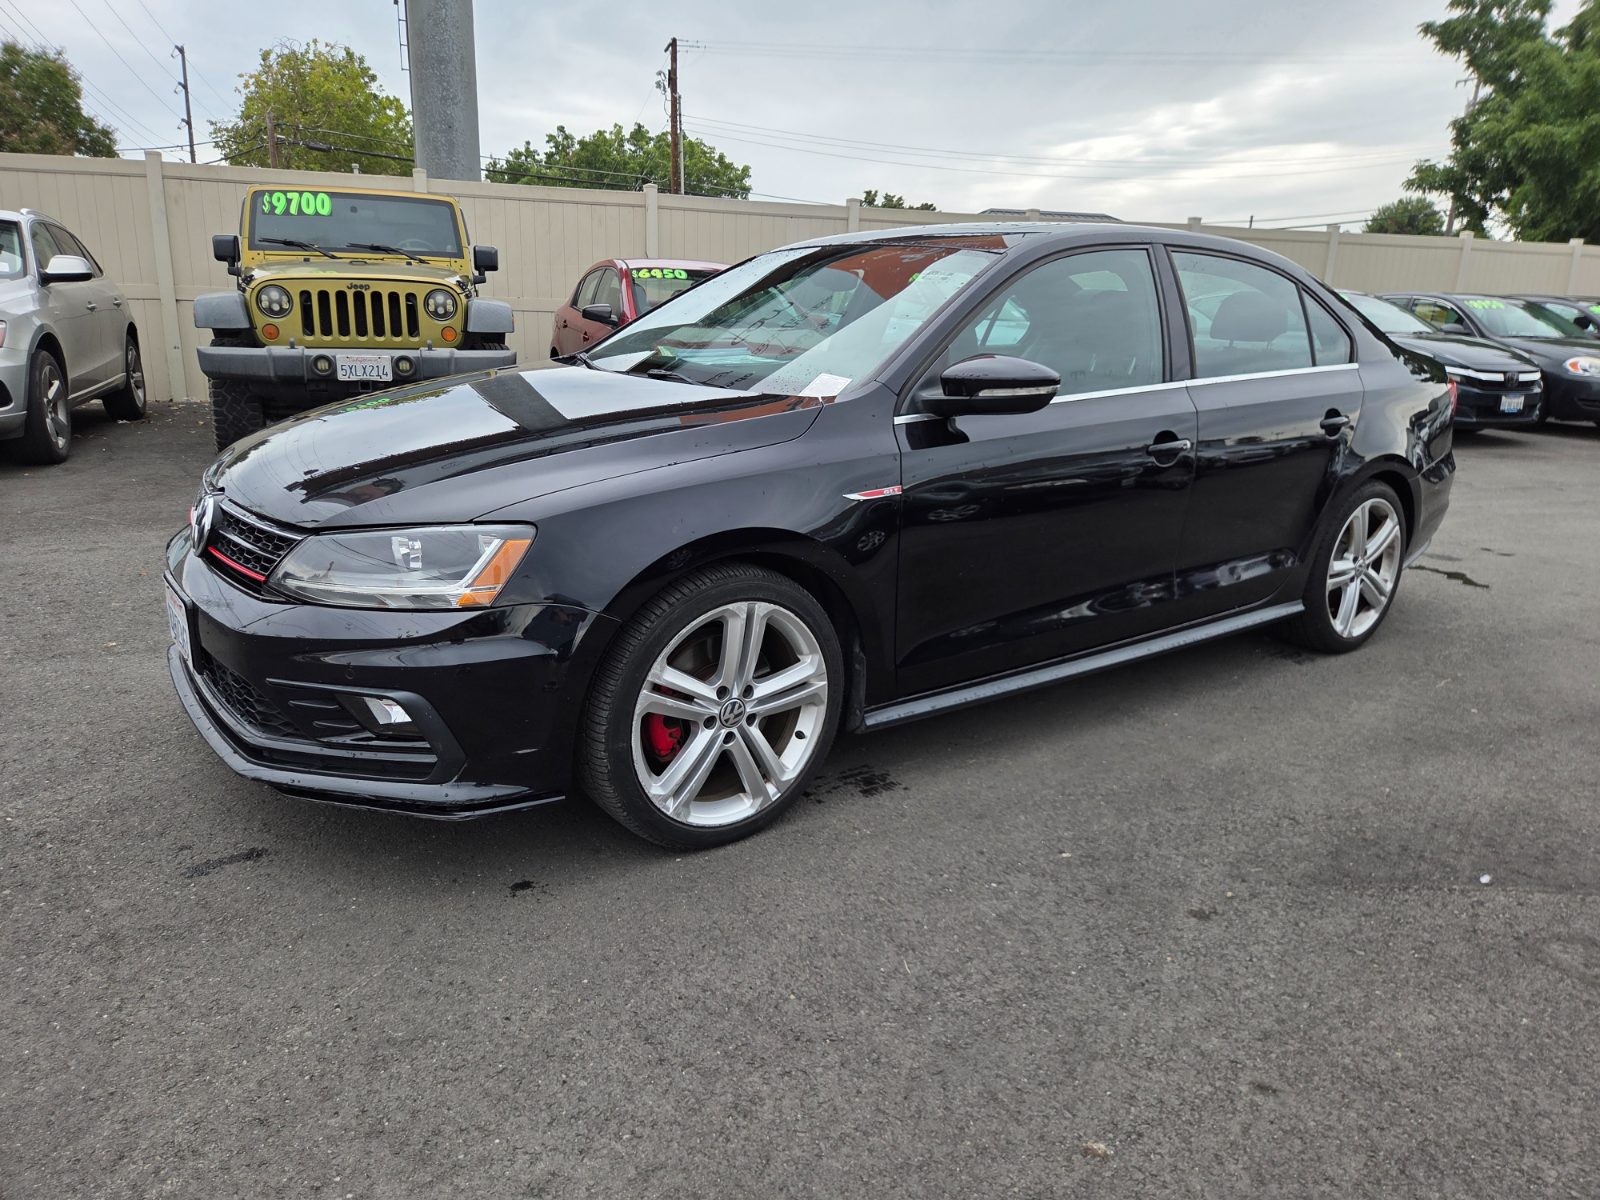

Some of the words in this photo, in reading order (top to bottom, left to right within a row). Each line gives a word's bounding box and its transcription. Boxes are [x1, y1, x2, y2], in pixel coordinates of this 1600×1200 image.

[262, 191, 332, 216] $9700
[346, 282, 370, 291] Jeep
[340, 364, 389, 377] 5XLX214
